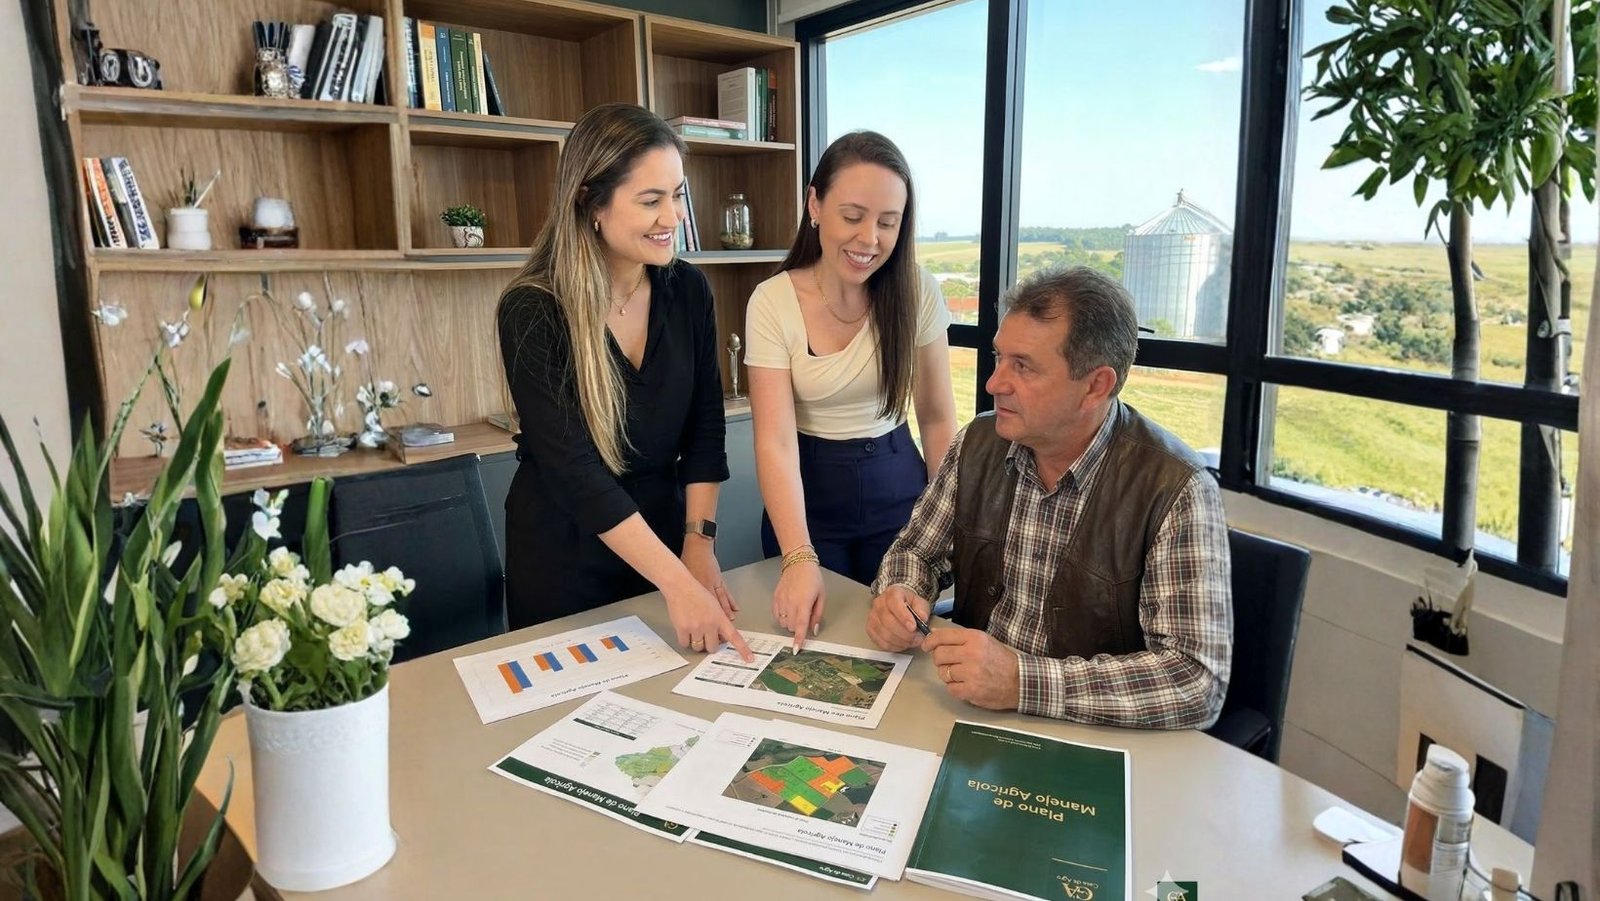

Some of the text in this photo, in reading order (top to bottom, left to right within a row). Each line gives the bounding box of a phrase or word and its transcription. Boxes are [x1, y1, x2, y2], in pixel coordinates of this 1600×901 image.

[575, 786, 608, 803] Manejo
[605, 797, 617, 808] de
[993, 796, 1064, 823] Plano de
[1035, 793, 1096, 817] Manejo
[827, 833, 854, 848] Manejo
